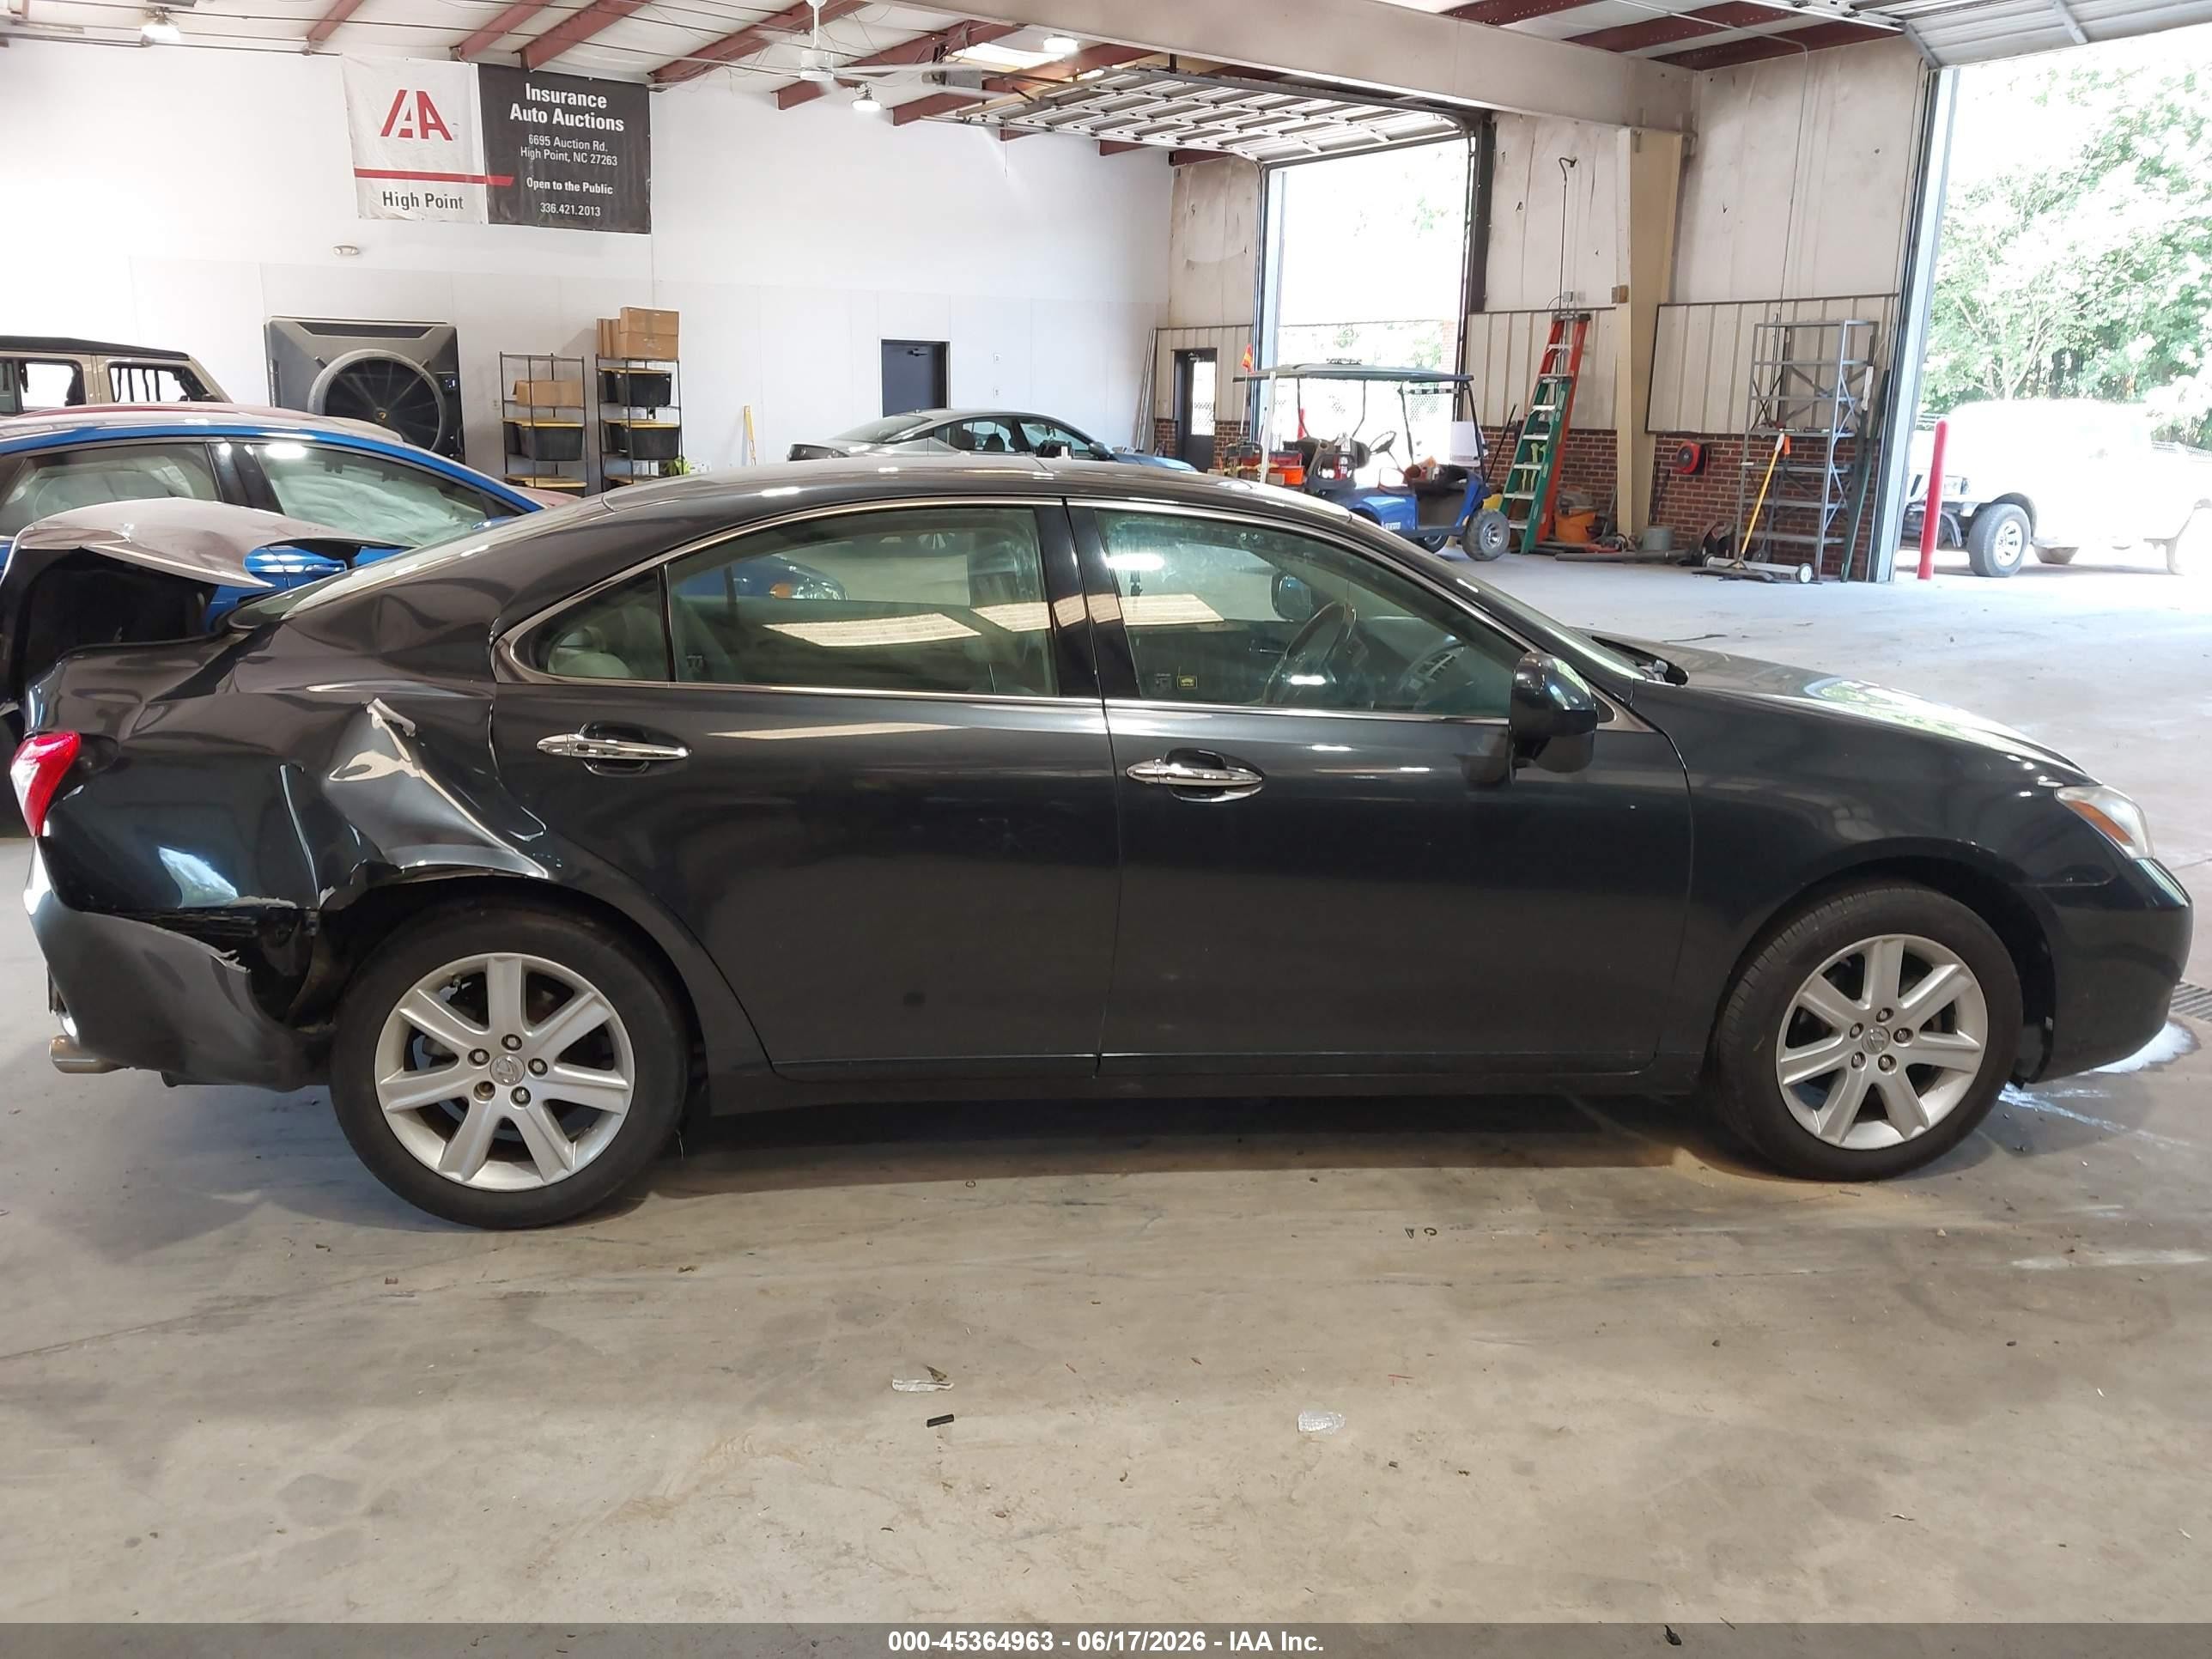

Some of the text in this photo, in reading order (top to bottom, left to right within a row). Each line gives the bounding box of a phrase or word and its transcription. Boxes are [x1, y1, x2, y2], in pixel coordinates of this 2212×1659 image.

[526, 83, 607, 108] Insurance
[510, 103, 624, 131] Auto Auctions
[528, 134, 608, 152] 6695 Auction Rd.
[520, 146, 617, 166] High Point, NC 27263
[526, 177, 613, 195] Open to the Public
[382, 191, 464, 210] High Point
[540, 202, 601, 216] 336.421.2013
